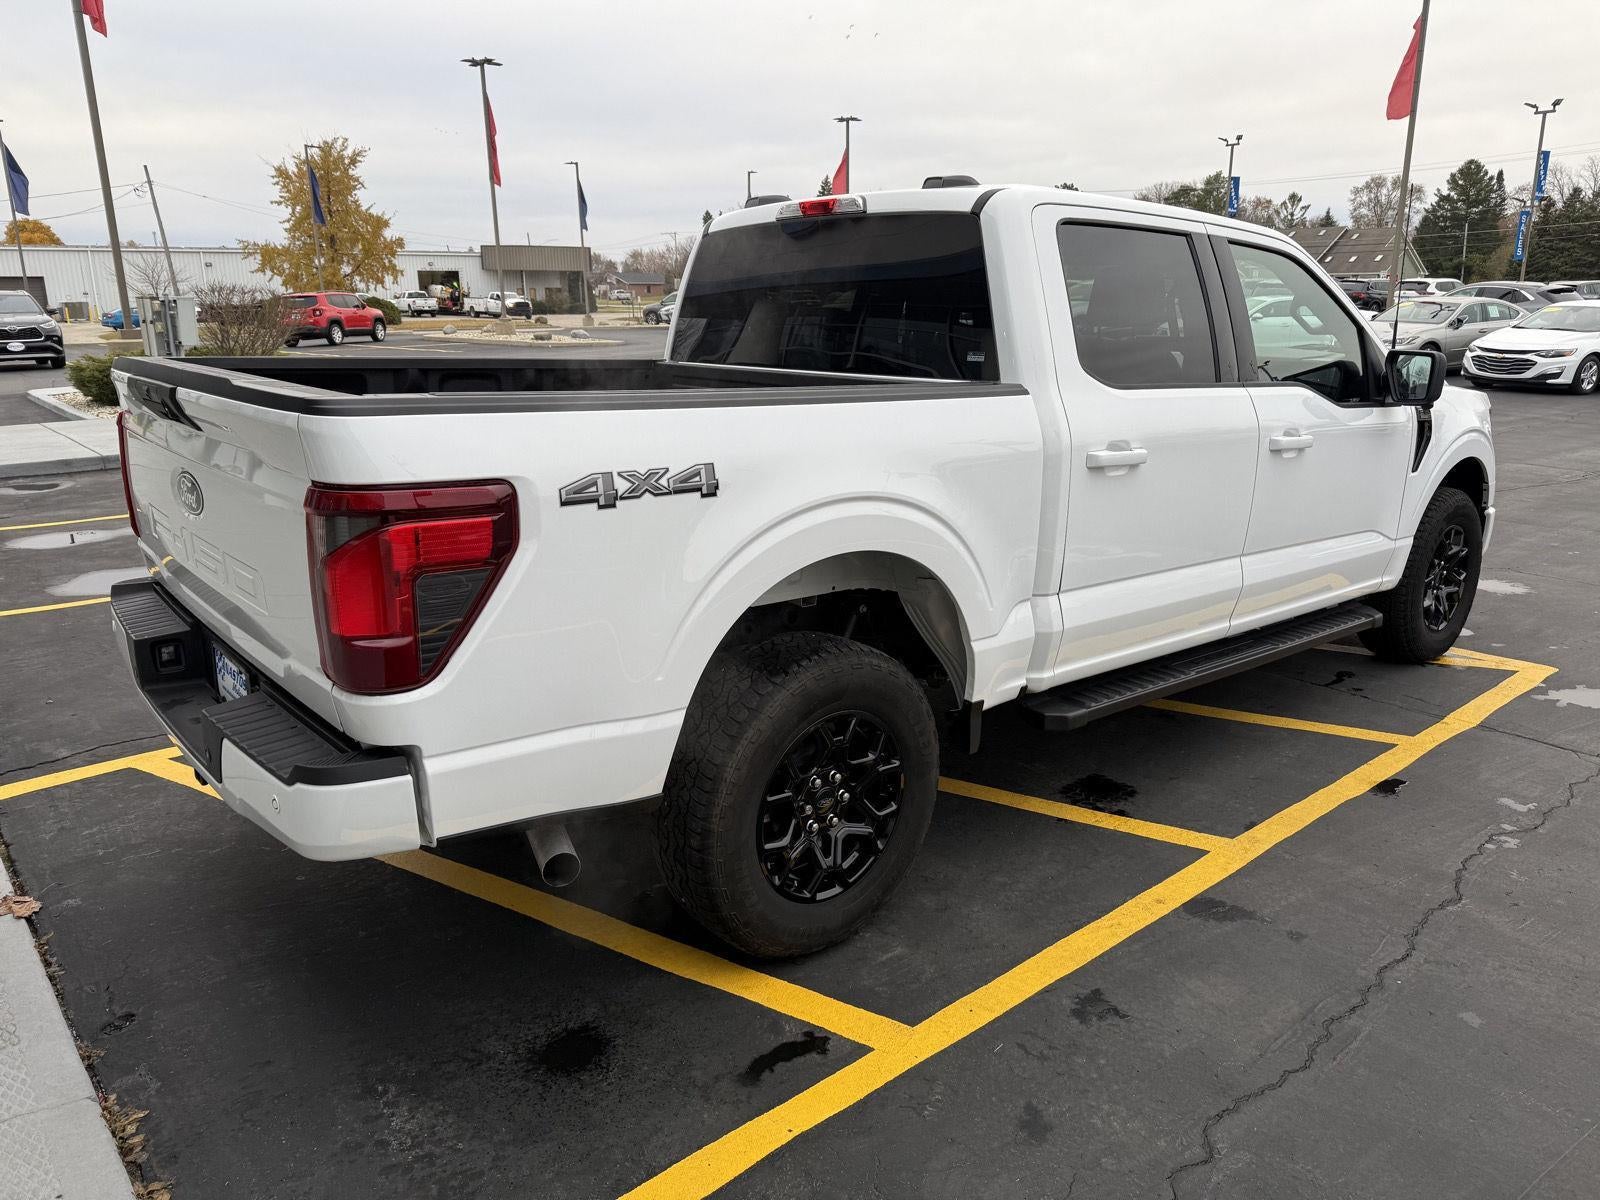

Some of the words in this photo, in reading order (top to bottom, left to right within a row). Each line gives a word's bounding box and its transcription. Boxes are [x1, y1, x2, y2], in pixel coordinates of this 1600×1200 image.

[1516, 214, 1527, 256] SALES
[180, 476, 198, 509] Ford
[148, 502, 270, 617] FORD
